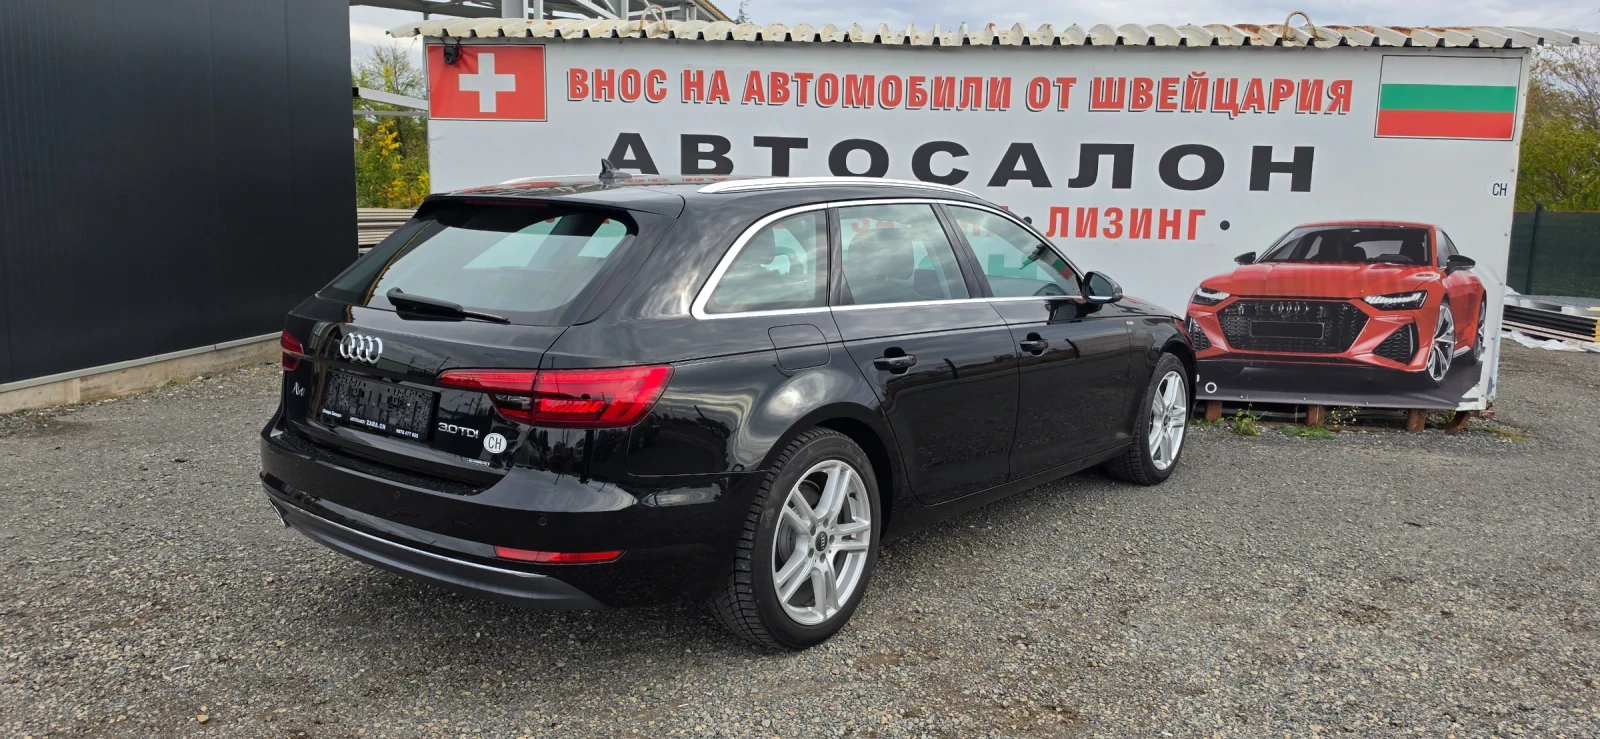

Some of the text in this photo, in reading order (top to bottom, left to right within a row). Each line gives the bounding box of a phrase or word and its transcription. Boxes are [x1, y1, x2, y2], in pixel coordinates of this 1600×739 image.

[567, 68, 1353, 120] ВНОС НА АВТОМОБИЛИ ОТ ШВЕЙЦАРИЯ
[604, 132, 1315, 192] АВТОСАЛОН
[1492, 182, 1508, 197] CH
[1046, 206, 1206, 240] ЛИЗИНГ
[488, 436, 502, 450] CH
